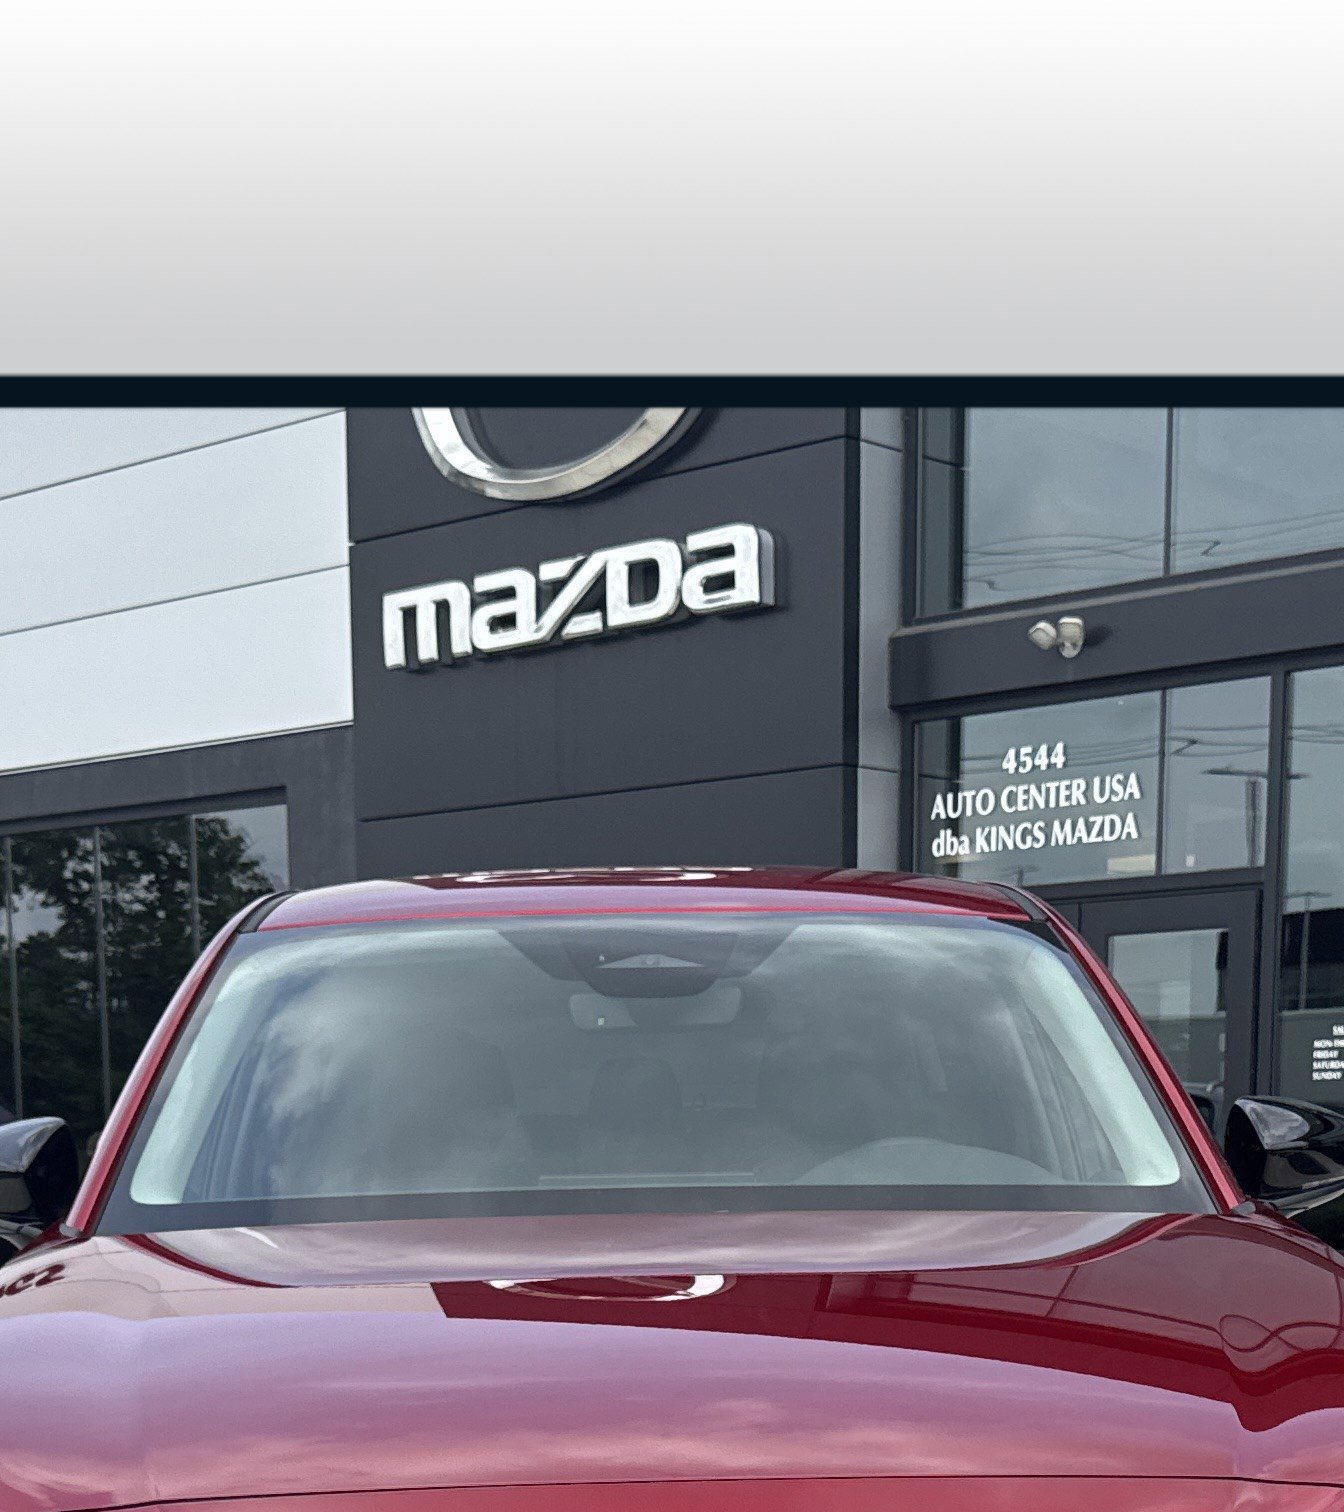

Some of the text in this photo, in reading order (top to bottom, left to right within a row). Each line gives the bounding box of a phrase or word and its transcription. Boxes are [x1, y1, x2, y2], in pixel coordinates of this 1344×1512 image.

[1002, 741, 1067, 774] 4544
[931, 772, 1141, 820] AUTO CENTER USA
[932, 812, 1138, 858] dba KINGS MAZDA
